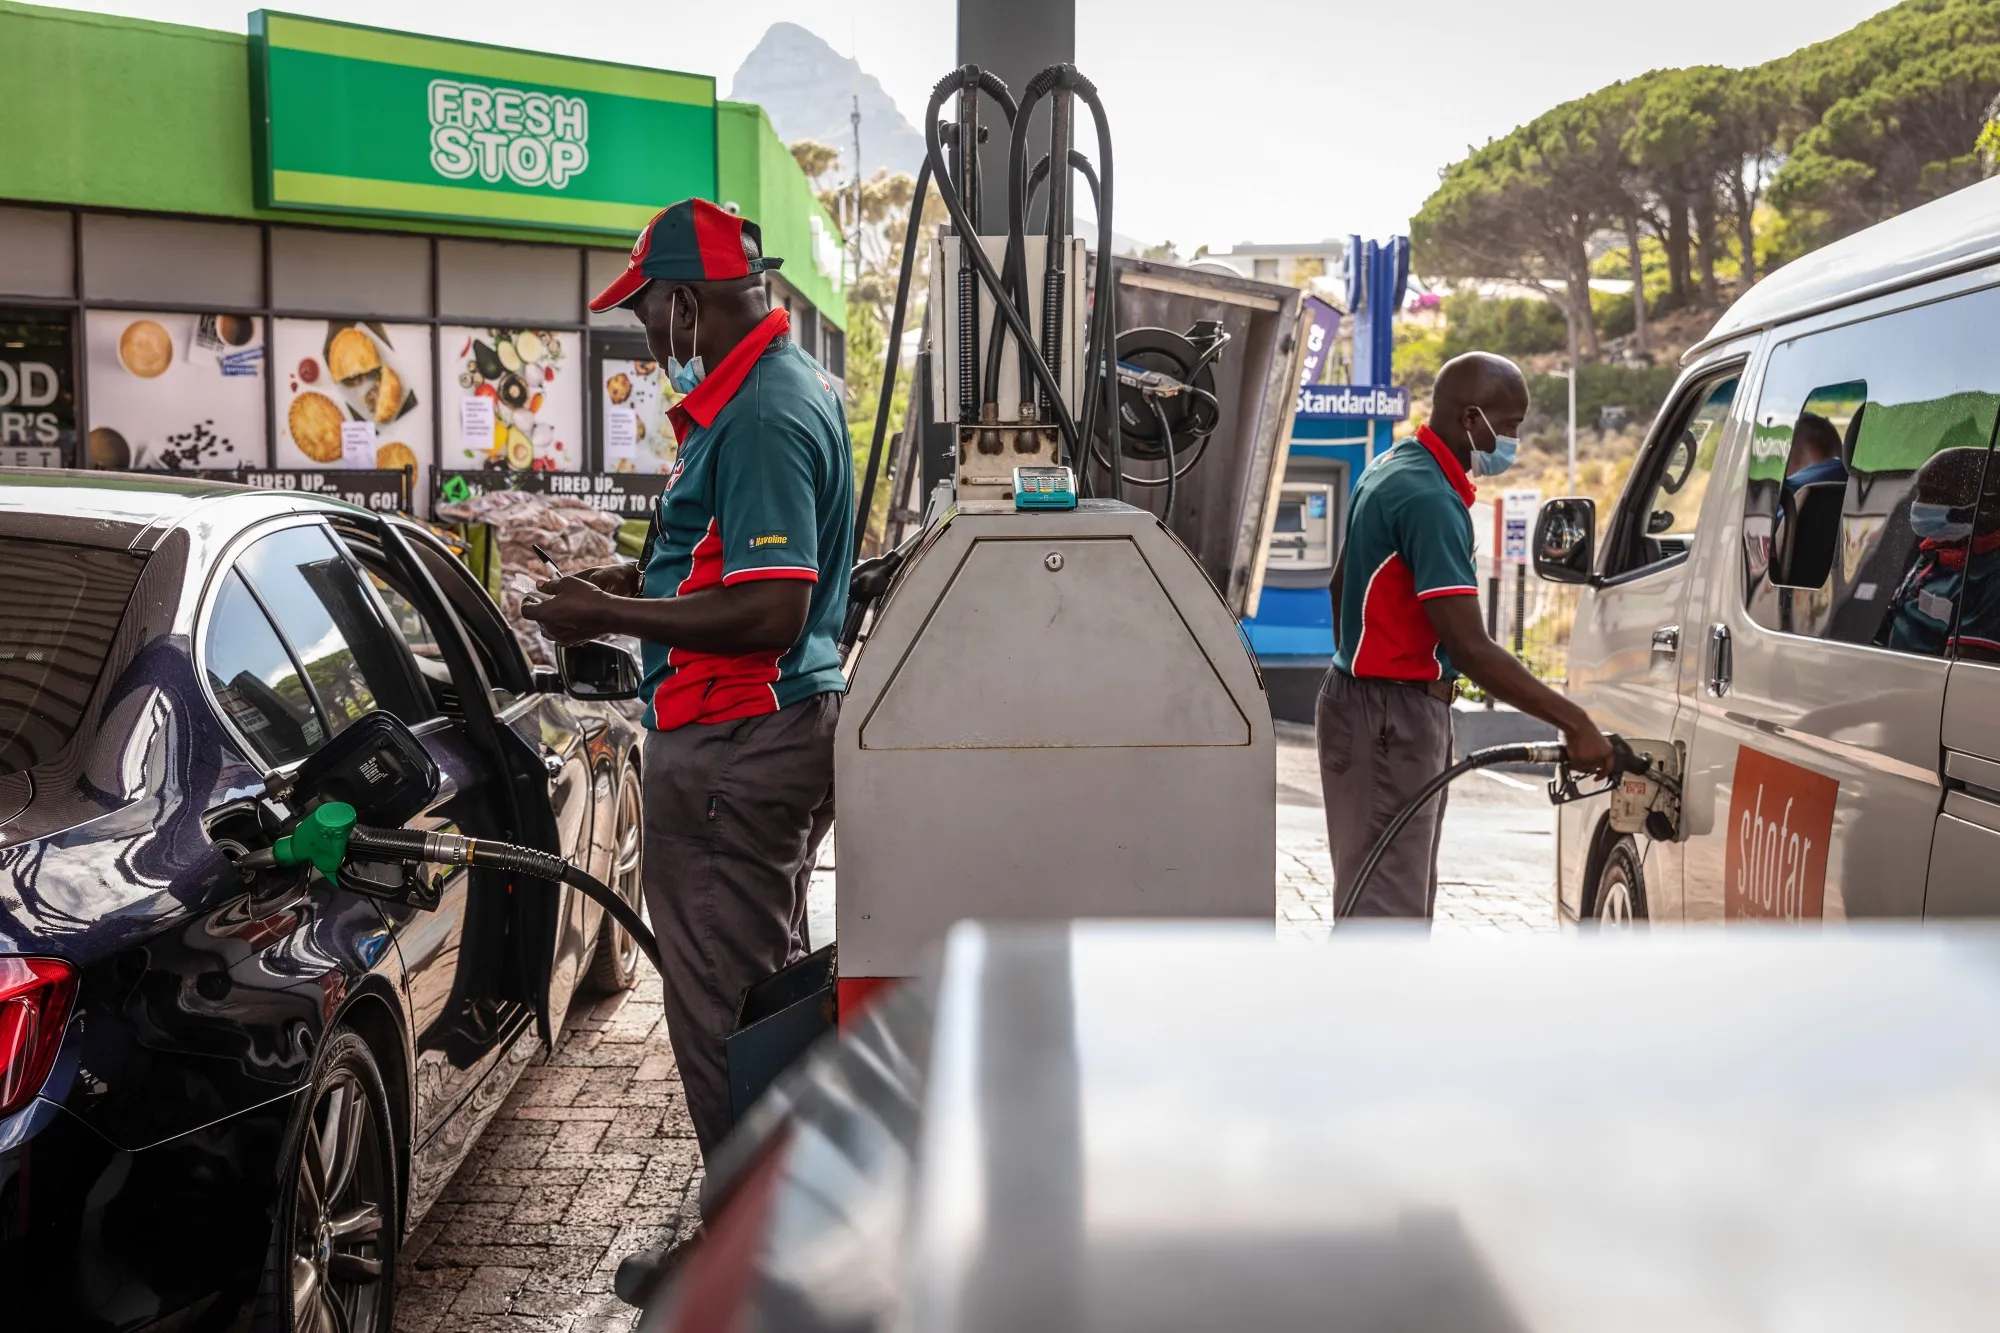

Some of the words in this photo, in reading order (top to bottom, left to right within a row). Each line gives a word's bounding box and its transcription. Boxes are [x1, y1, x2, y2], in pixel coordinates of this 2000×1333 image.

[430, 81, 587, 143] FRESH
[431, 126, 587, 189] STOP
[1295, 388, 1377, 415] Standard
[1377, 391, 1404, 416] Bank
[0, 451, 52, 468] ET
[247, 473, 297, 490] FIRED
[301, 473, 338, 491] UP...
[550, 476, 591, 493] FIRED
[594, 476, 625, 493] UP...
[369, 491, 398, 510] GO!
[583, 493, 627, 511] READY
[629, 494, 647, 512] TO
[755, 534, 788, 547] Havoline
[1737, 783, 1812, 928] shofar
